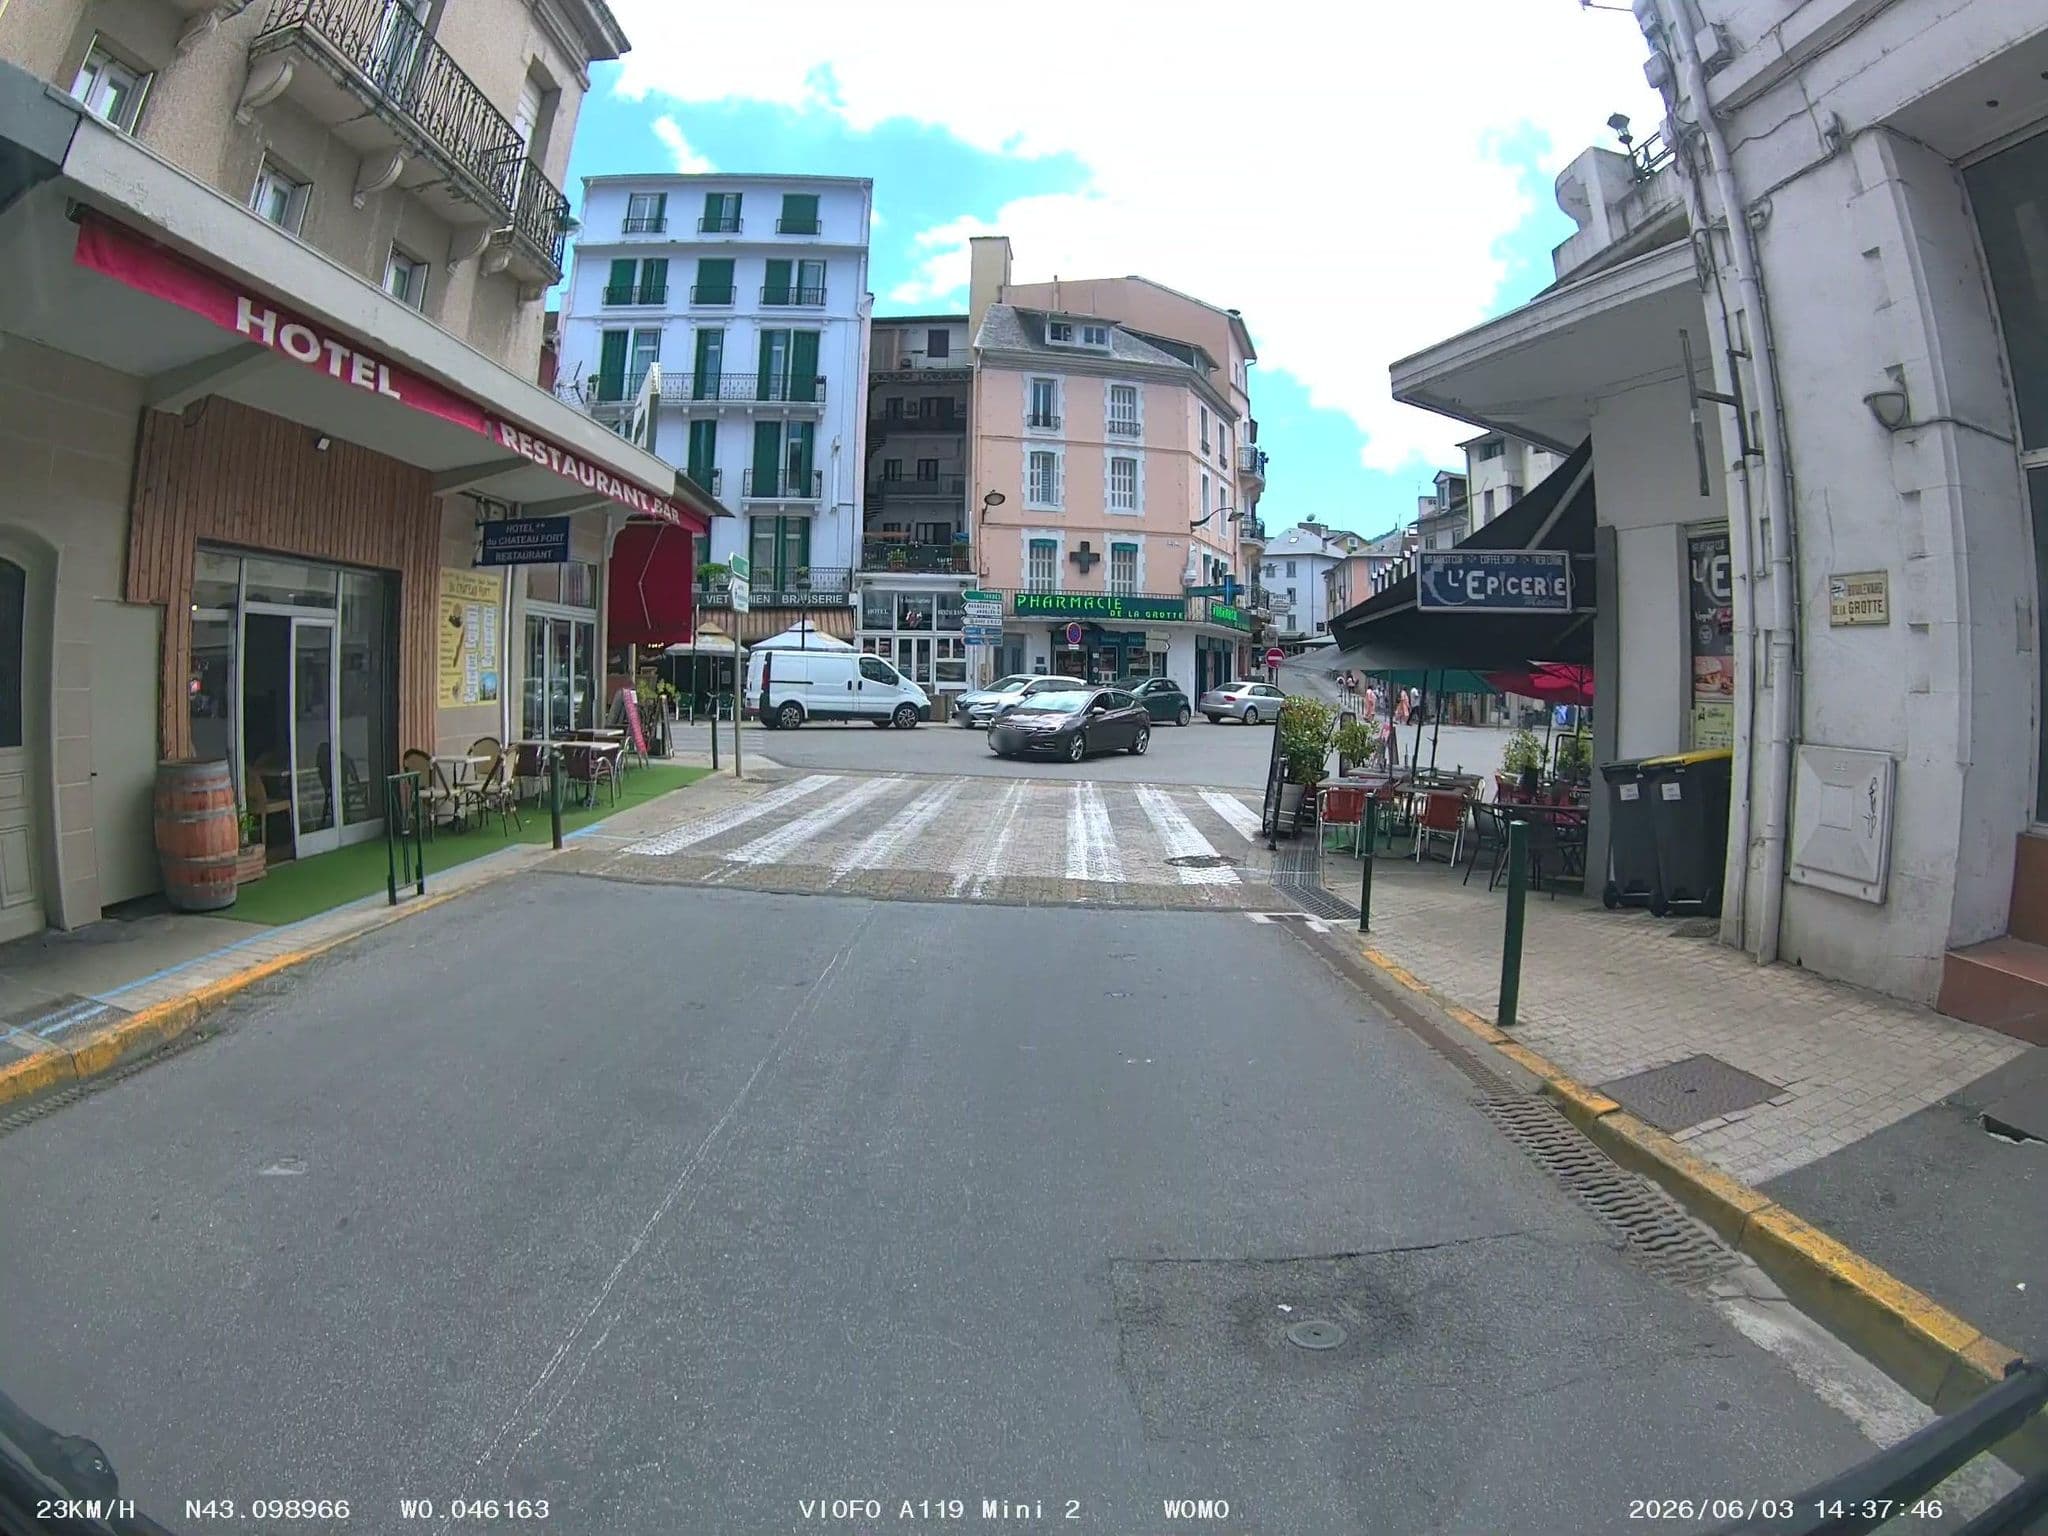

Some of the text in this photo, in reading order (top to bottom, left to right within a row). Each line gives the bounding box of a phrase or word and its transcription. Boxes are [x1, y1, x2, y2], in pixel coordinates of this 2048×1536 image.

[236, 296, 401, 400] HOTEL
[500, 422, 681, 525] RESTAURANT BAR
[495, 549, 553, 561] RESTAURANT
[705, 594, 771, 605] VIETIEN
[1016, 594, 1123, 610] PHARMACIE
[1848, 599, 1884, 615] GROTTE
[1109, 609, 1184, 620] DE LA GROTTE
